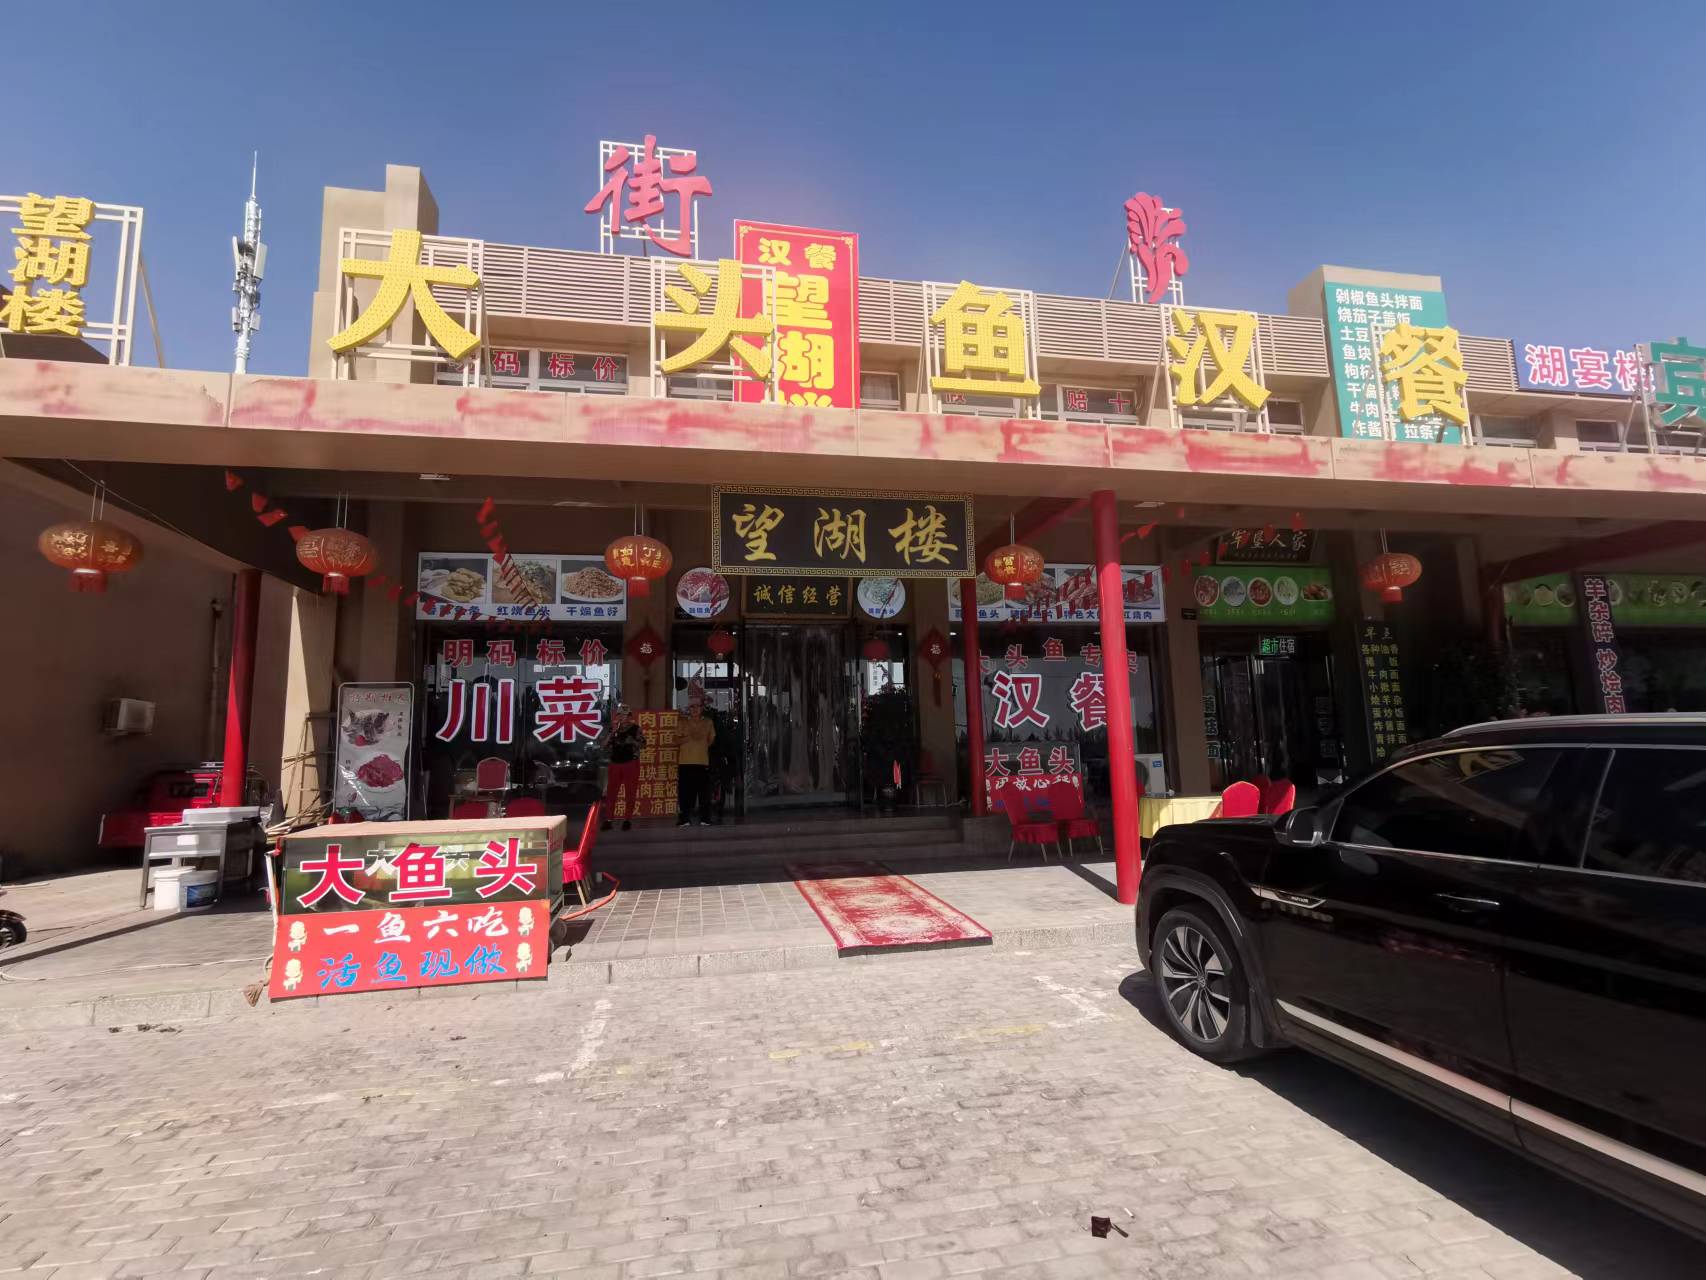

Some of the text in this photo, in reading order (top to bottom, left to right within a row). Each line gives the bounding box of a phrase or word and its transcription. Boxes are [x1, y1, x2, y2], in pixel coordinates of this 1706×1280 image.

[584, 135, 713, 257] 街
[0, 192, 94, 336] 望湖楼
[757, 237, 837, 271] 汉餐
[1335, 288, 1424, 311] 剁椒鱼头拌面
[731, 502, 959, 566] 望湖楼
[753, 584, 843, 607] 诚信经营
[442, 638, 608, 668] 明码标价
[436, 675, 604, 744] 川菜
[991, 670, 1109, 732] 汉餐
[984, 745, 1075, 776] 大鱼头
[296, 837, 538, 909] 大鱼头
[323, 906, 509, 944] 一鱼六吃
[316, 943, 508, 989] 活鱼现做
